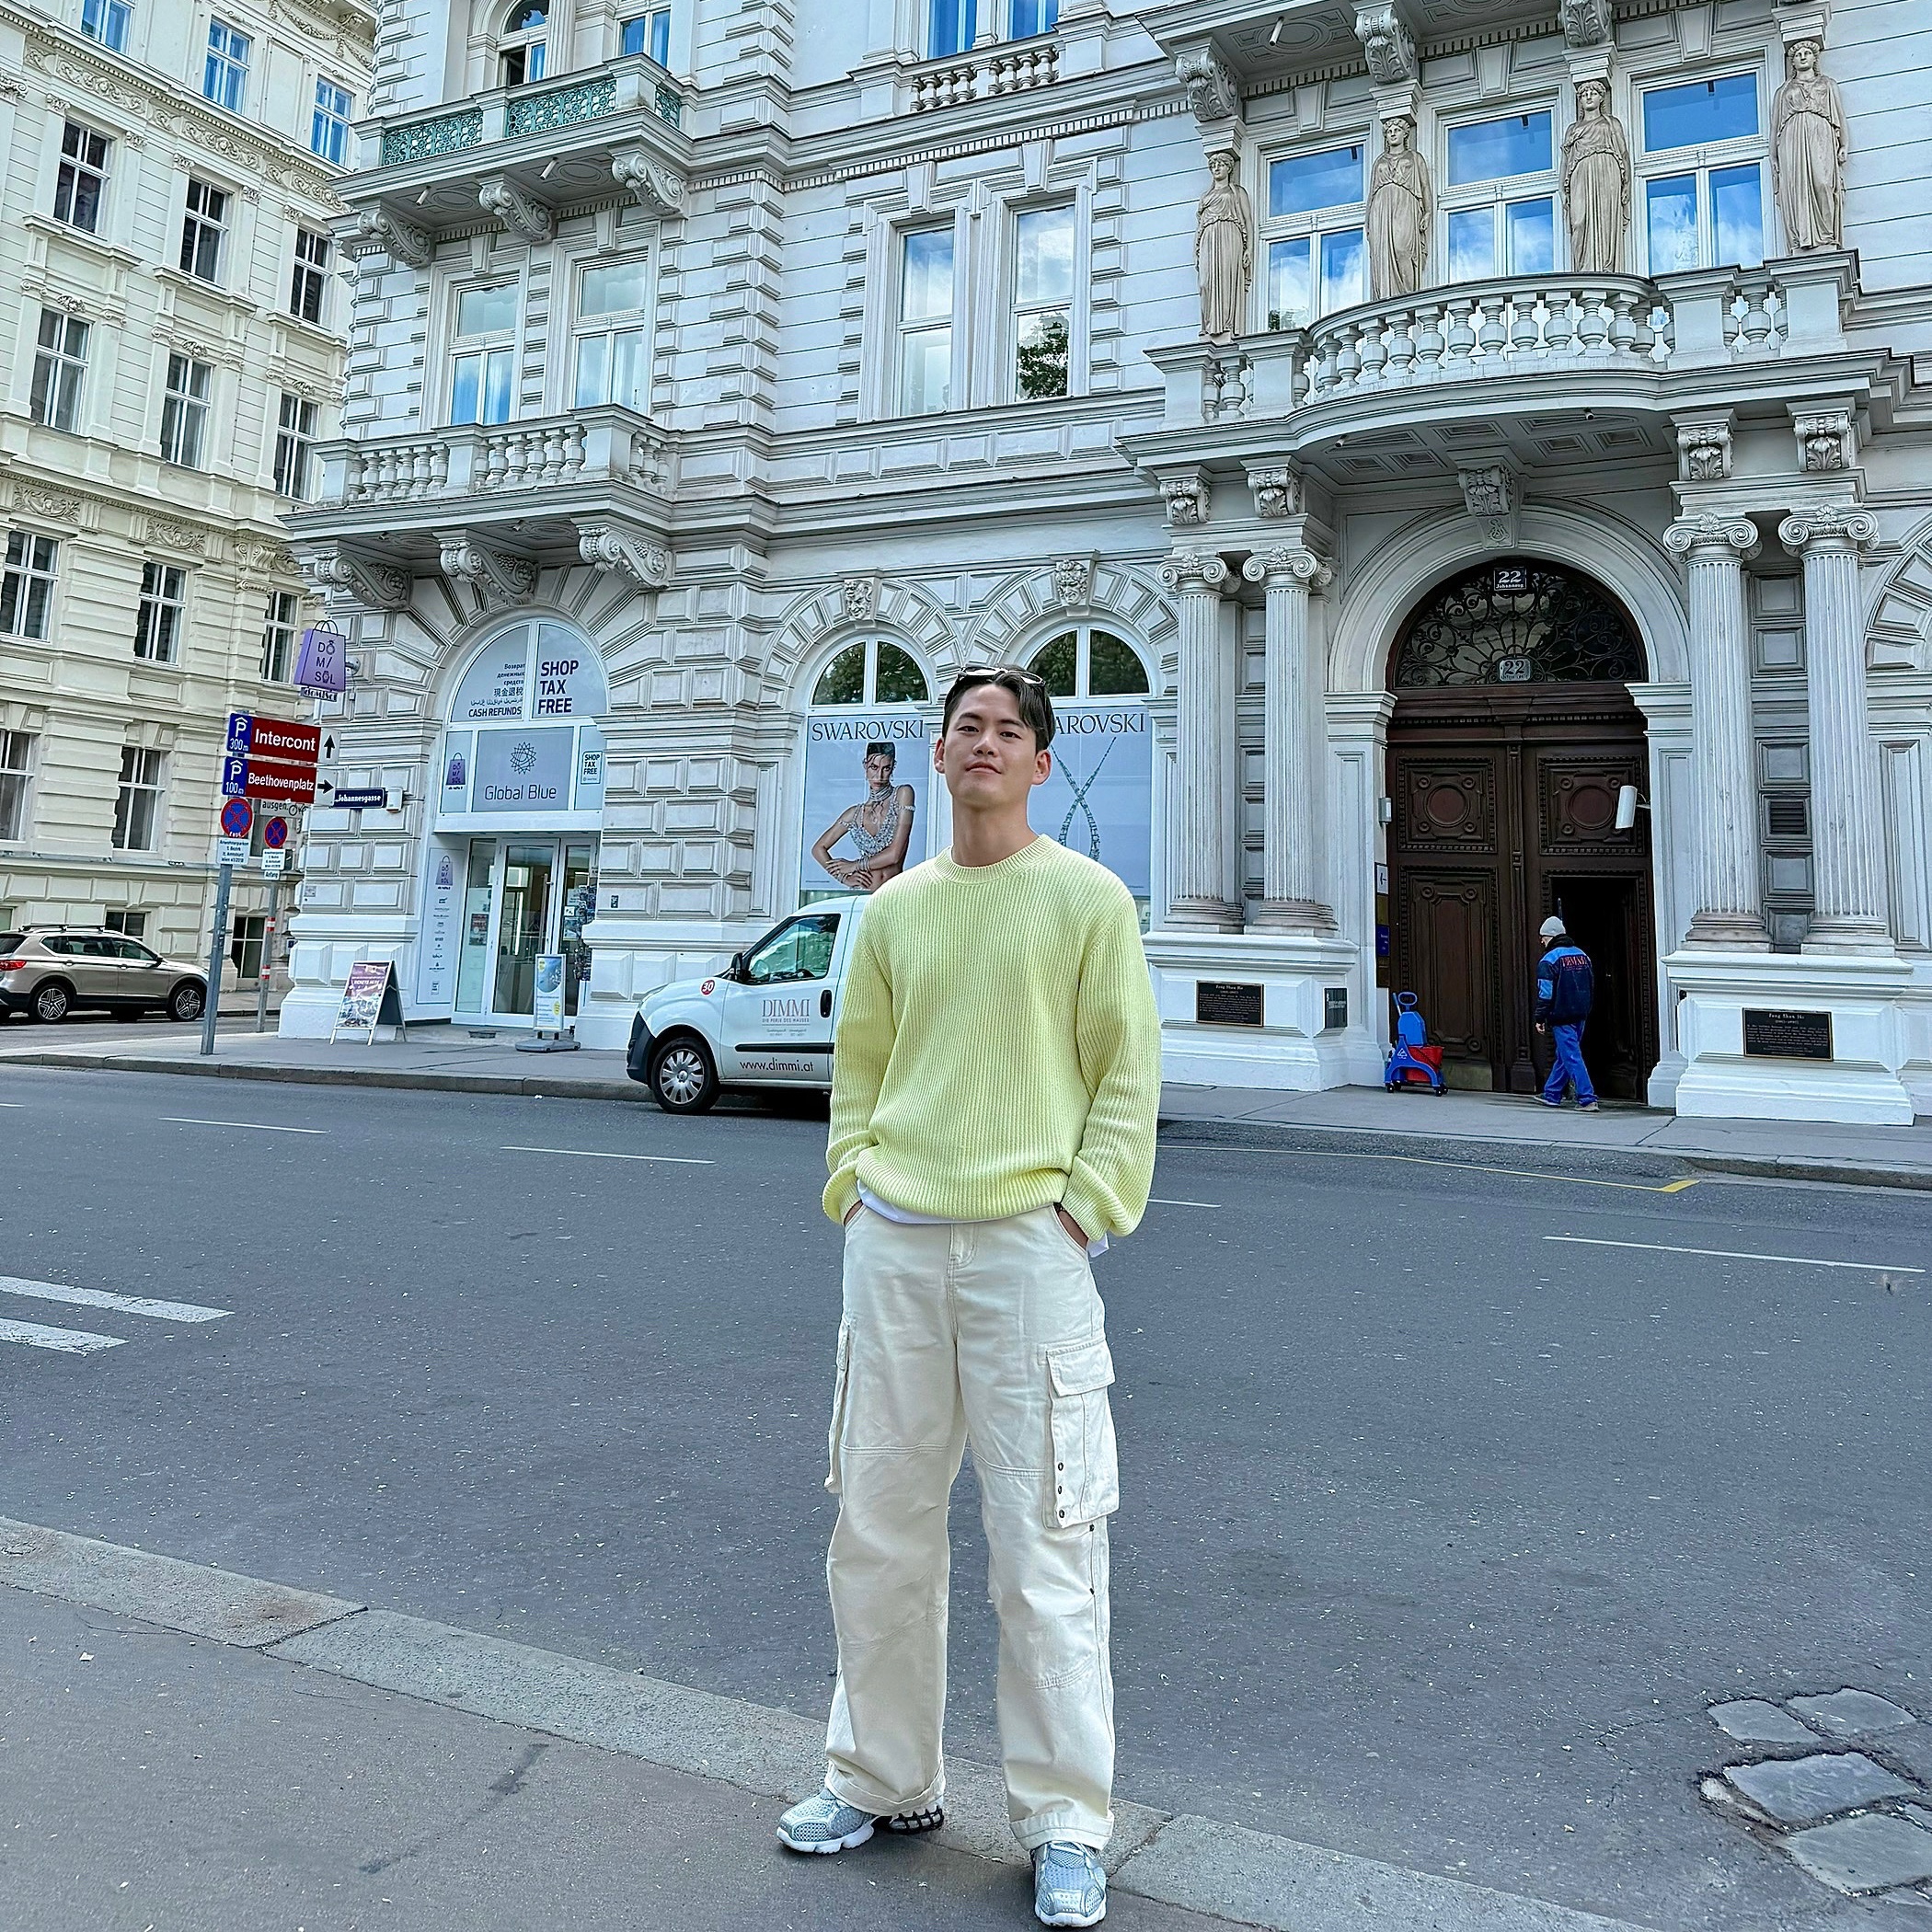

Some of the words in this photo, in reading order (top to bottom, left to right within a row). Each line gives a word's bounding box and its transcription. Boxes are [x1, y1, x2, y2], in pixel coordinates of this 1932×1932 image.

[1499, 570, 1522, 583] 22
[541, 660, 579, 676] SHOP
[1504, 660, 1525, 674] 22
[539, 680, 567, 695] TAX
[468, 707, 488, 718] CASH
[488, 706, 523, 717] REFUNDS
[537, 697, 572, 714] FREE
[236, 721, 247, 738] P
[811, 719, 925, 742] SWAROVSKI
[1054, 712, 1145, 735] AROVSKI
[255, 728, 316, 752] Intercont
[584, 753, 601, 762] SHOP
[231, 764, 243, 781] P
[583, 767, 598, 776] FREE
[248, 772, 315, 792] Beethovenplatz
[484, 785, 523, 800] Global
[528, 784, 558, 799] Blue
[262, 800, 289, 811] ausgen.
[701, 982, 713, 992] 30
[762, 998, 811, 1018] DIMMI
[739, 1057, 814, 1072] www.dimmi.at
